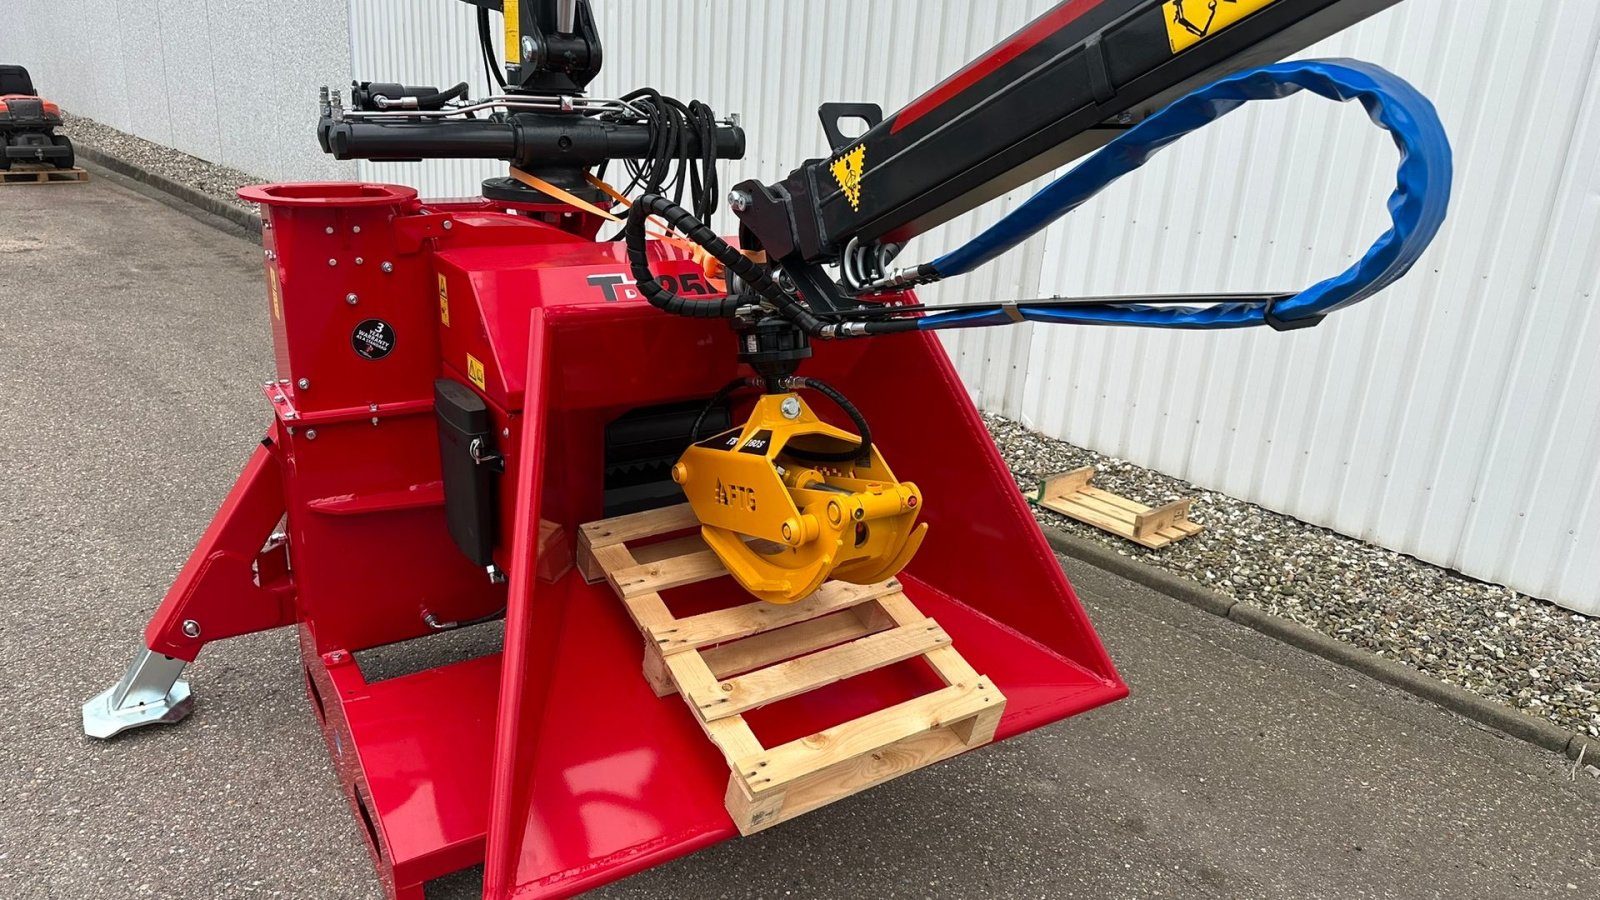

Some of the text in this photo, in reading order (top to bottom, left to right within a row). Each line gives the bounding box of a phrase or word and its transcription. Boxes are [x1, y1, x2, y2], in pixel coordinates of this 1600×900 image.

[374, 322, 385, 333] 3
[358, 329, 390, 347] WARRANTY
[369, 329, 384, 340] YEAR
[365, 338, 387, 351] STANDARD
[728, 484, 757, 512] FTG
